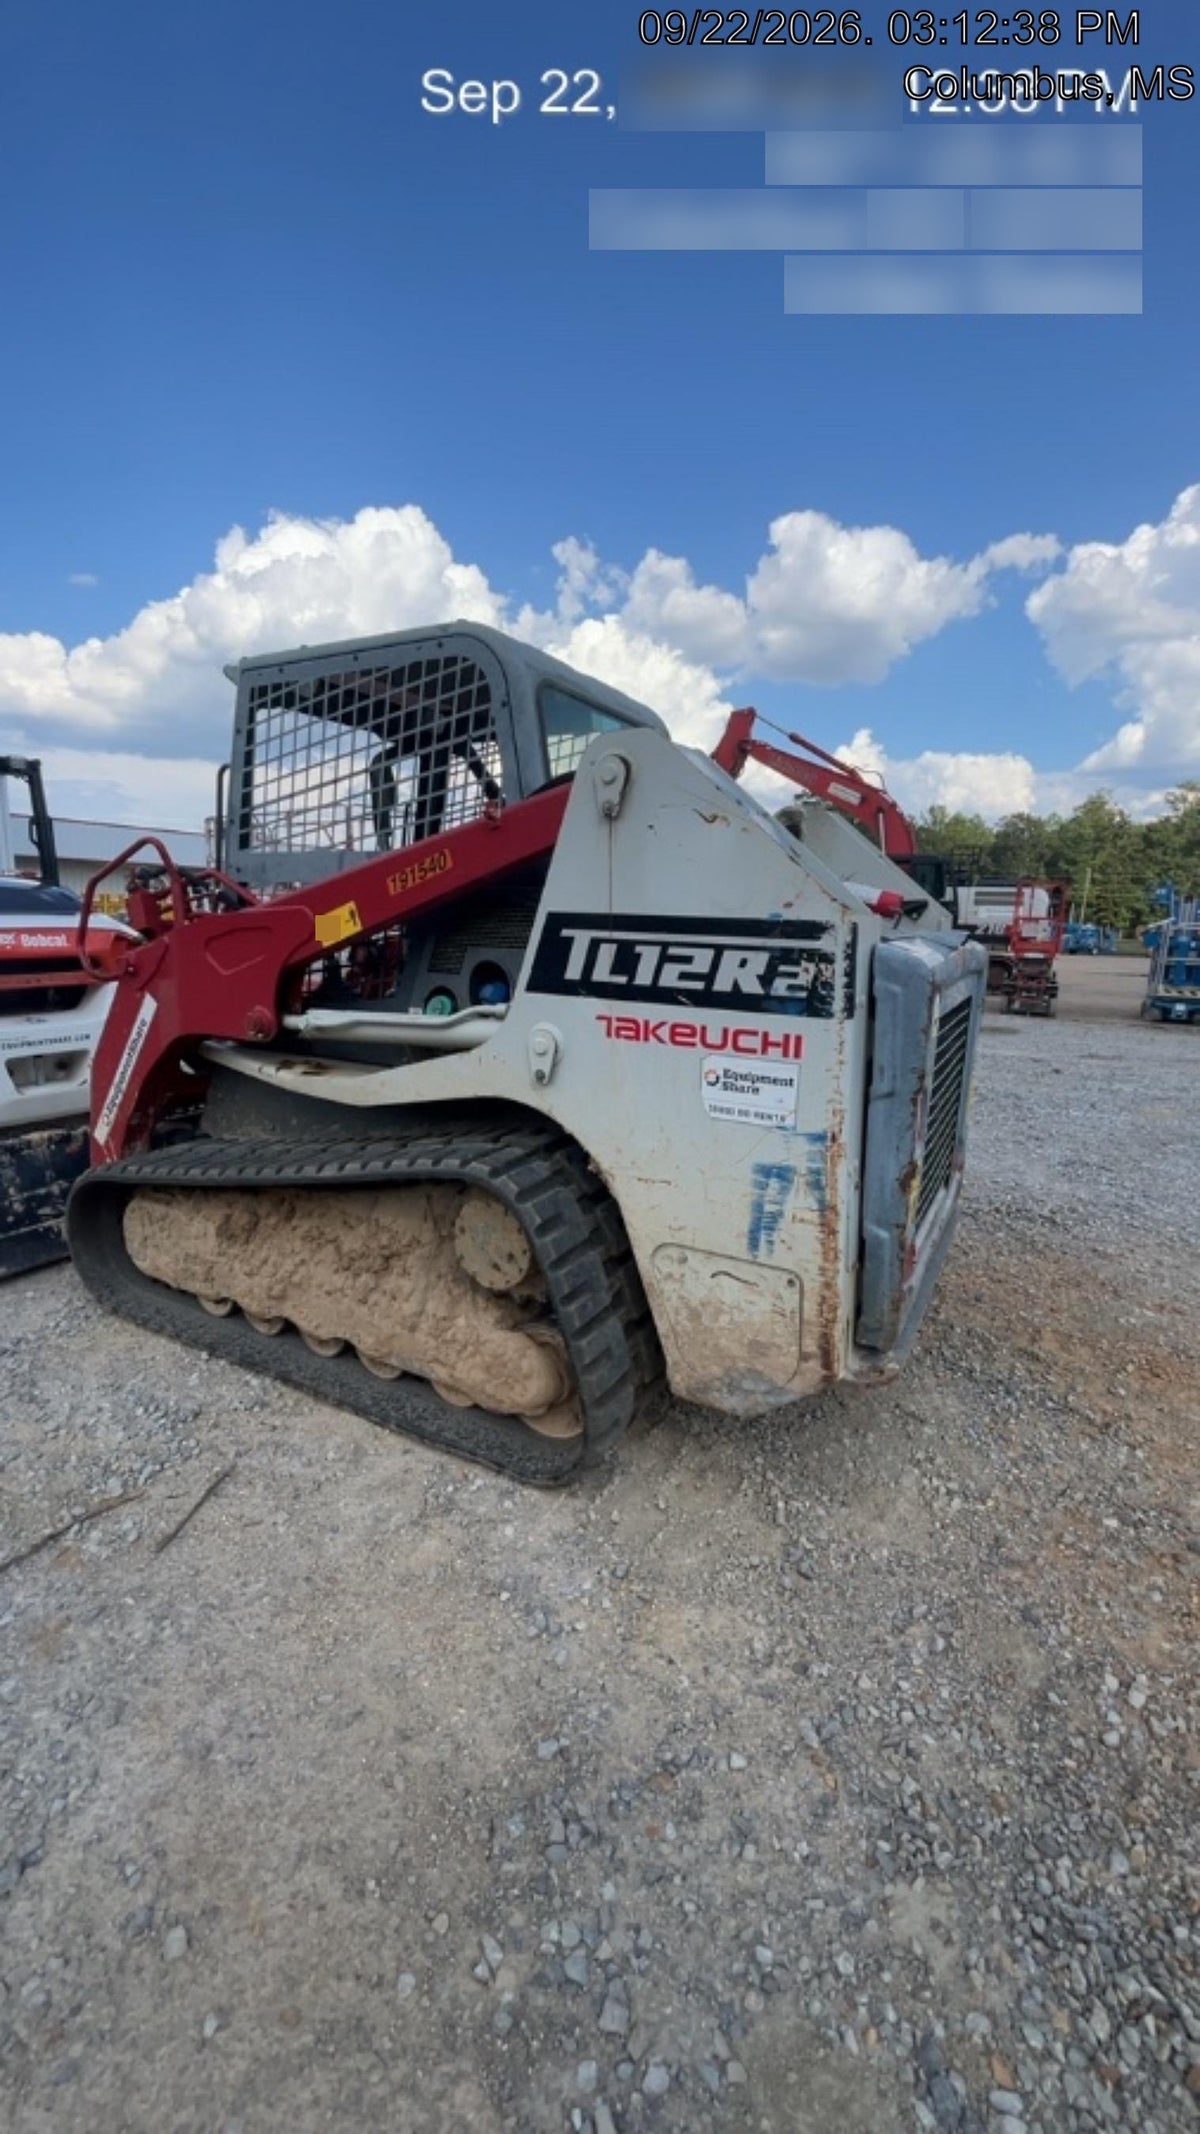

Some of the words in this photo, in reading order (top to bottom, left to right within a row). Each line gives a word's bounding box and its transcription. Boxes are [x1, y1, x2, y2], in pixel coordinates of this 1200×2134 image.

[389, 850, 448, 892] 191540
[20, 932, 69, 948] Bobcat
[722, 1068, 794, 1088] Equipment
[722, 1080, 760, 1096] Share
